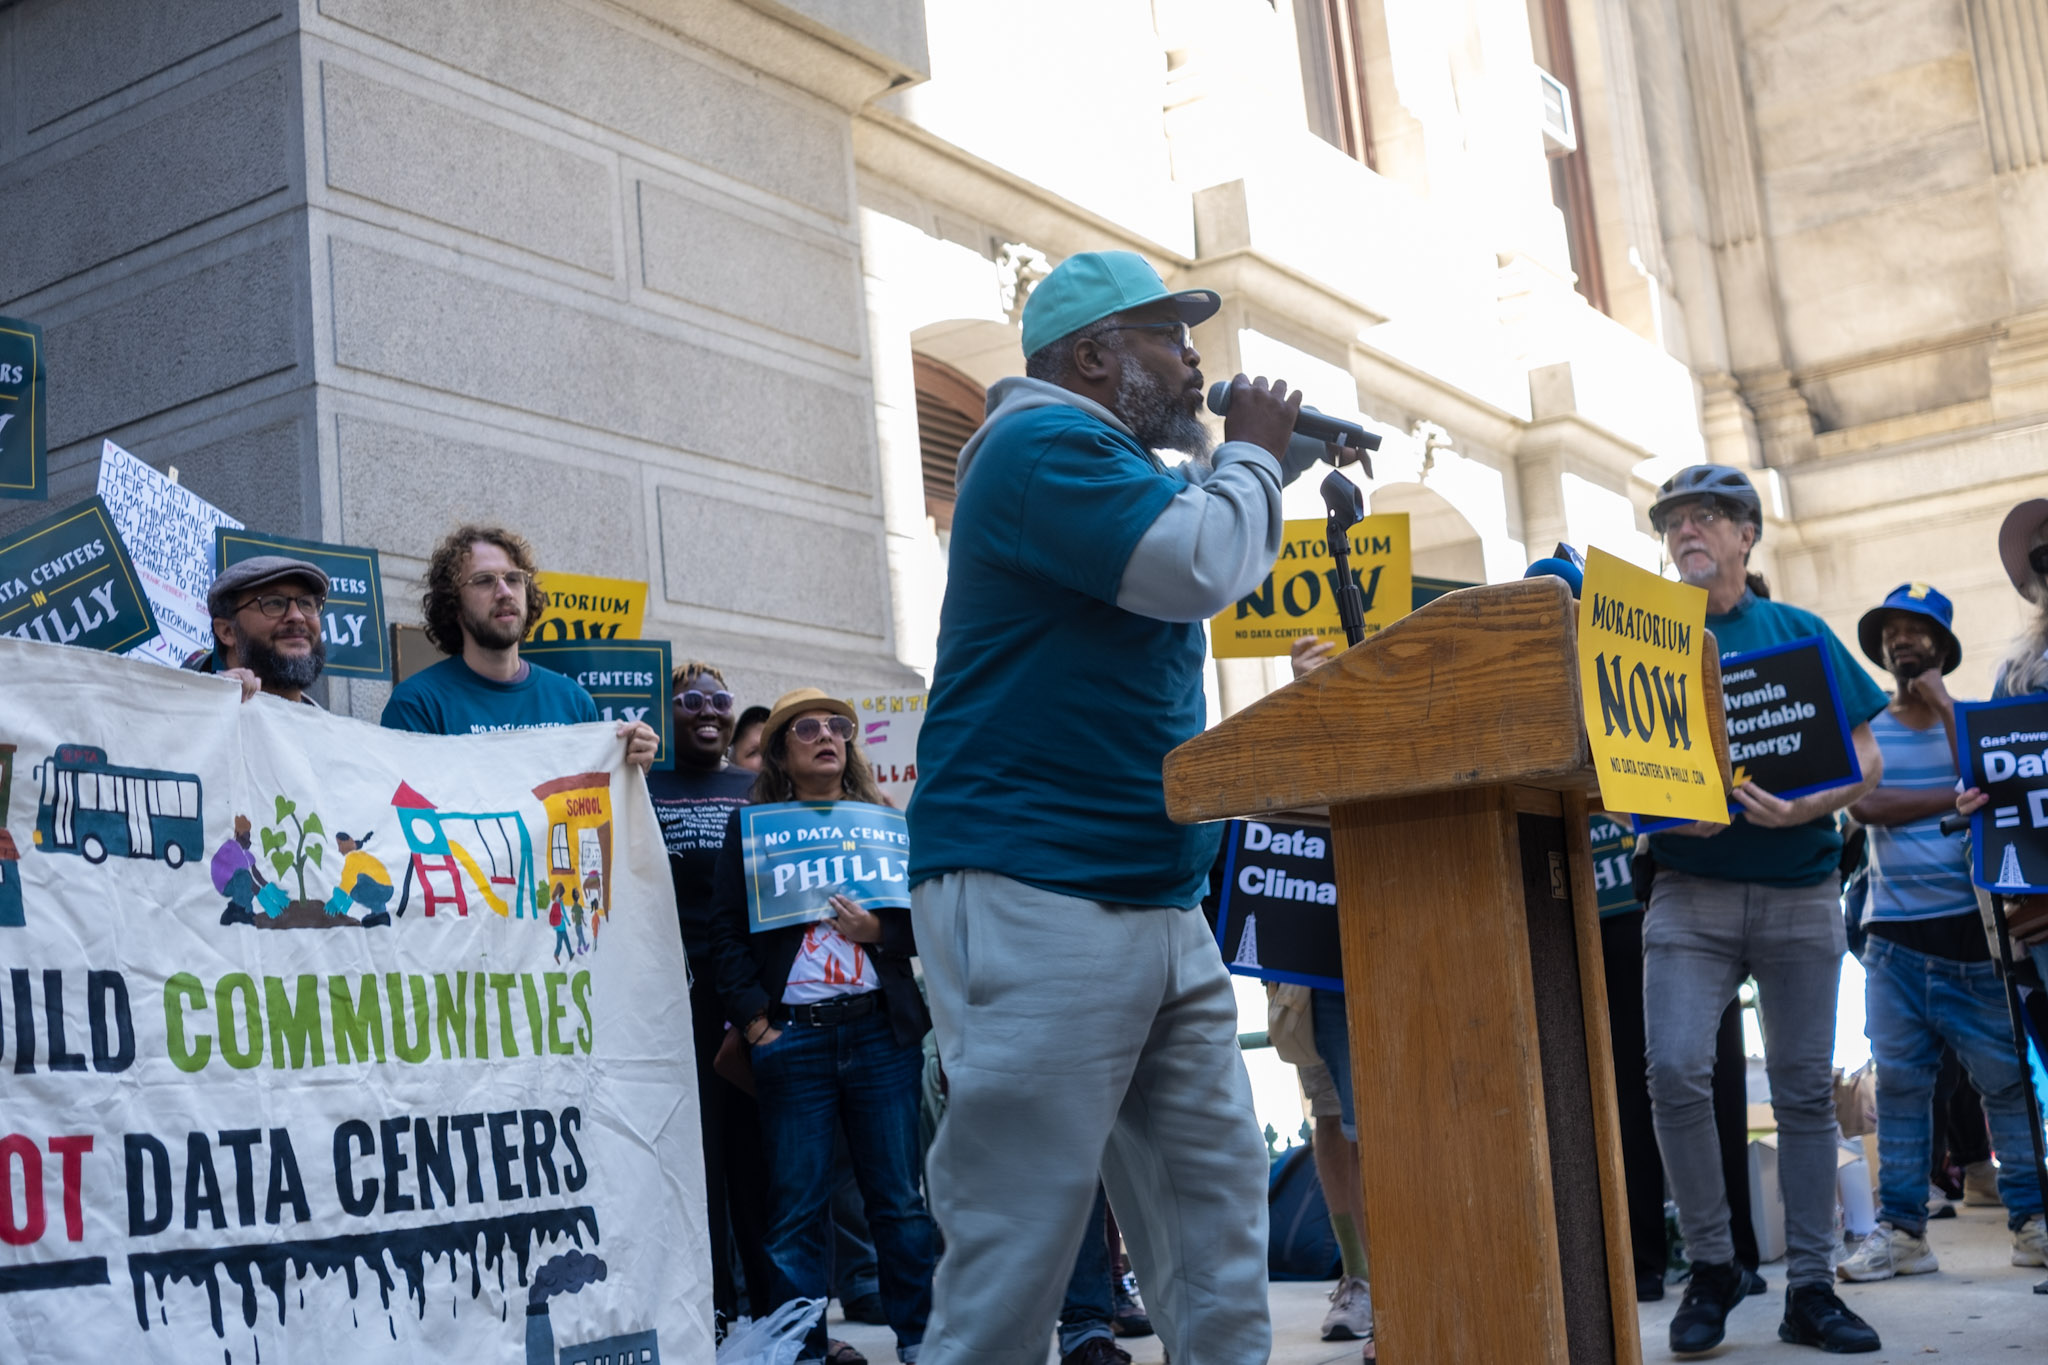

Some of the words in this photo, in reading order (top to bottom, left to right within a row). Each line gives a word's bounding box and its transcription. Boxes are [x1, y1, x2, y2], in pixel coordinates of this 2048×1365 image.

[102, 475, 119, 497] TO
[123, 489, 176, 531] MACHINES
[179, 524, 188, 540] IN
[103, 460, 143, 498] THEIR
[149, 487, 207, 537] THINKING
[160, 477, 190, 508] MEN
[99, 490, 132, 520] THAT
[137, 508, 161, 537] THIS
[30, 538, 105, 586] CENTERS
[176, 573, 187, 590] TO
[31, 589, 47, 608] IN
[1235, 629, 1247, 639] NO
[1250, 629, 1273, 639] DATA
[1275, 627, 1314, 638] CENTERS
[1317, 627, 1326, 635] IN
[1591, 592, 1691, 656] MORATORIUM
[577, 671, 653, 687] CENTERS
[1594, 652, 1692, 751] NOW
[1726, 701, 1816, 737] fordable
[1729, 731, 1801, 762] Energy
[1610, 756, 1621, 773] NO
[1623, 758, 1637, 775] DATA
[1637, 760, 1663, 780] CENTERS
[1663, 767, 1670, 781] IN
[1670, 767, 1689, 784] PHILLY
[566, 796, 602, 817] SCHOOL
[664, 829, 697, 840] Youth
[765, 830, 791, 847] NO
[797, 826, 844, 842] DATA
[850, 827, 909, 845] CENTE
[842, 840, 856, 851] IN
[1243, 821, 1326, 859] Data
[0, 967, 136, 1075] ILD
[163, 968, 593, 1073] COMMUNITIES
[0, 1132, 94, 1246] OT
[123, 1128, 311, 1238] DATA
[333, 1106, 589, 1218] CENTERS
